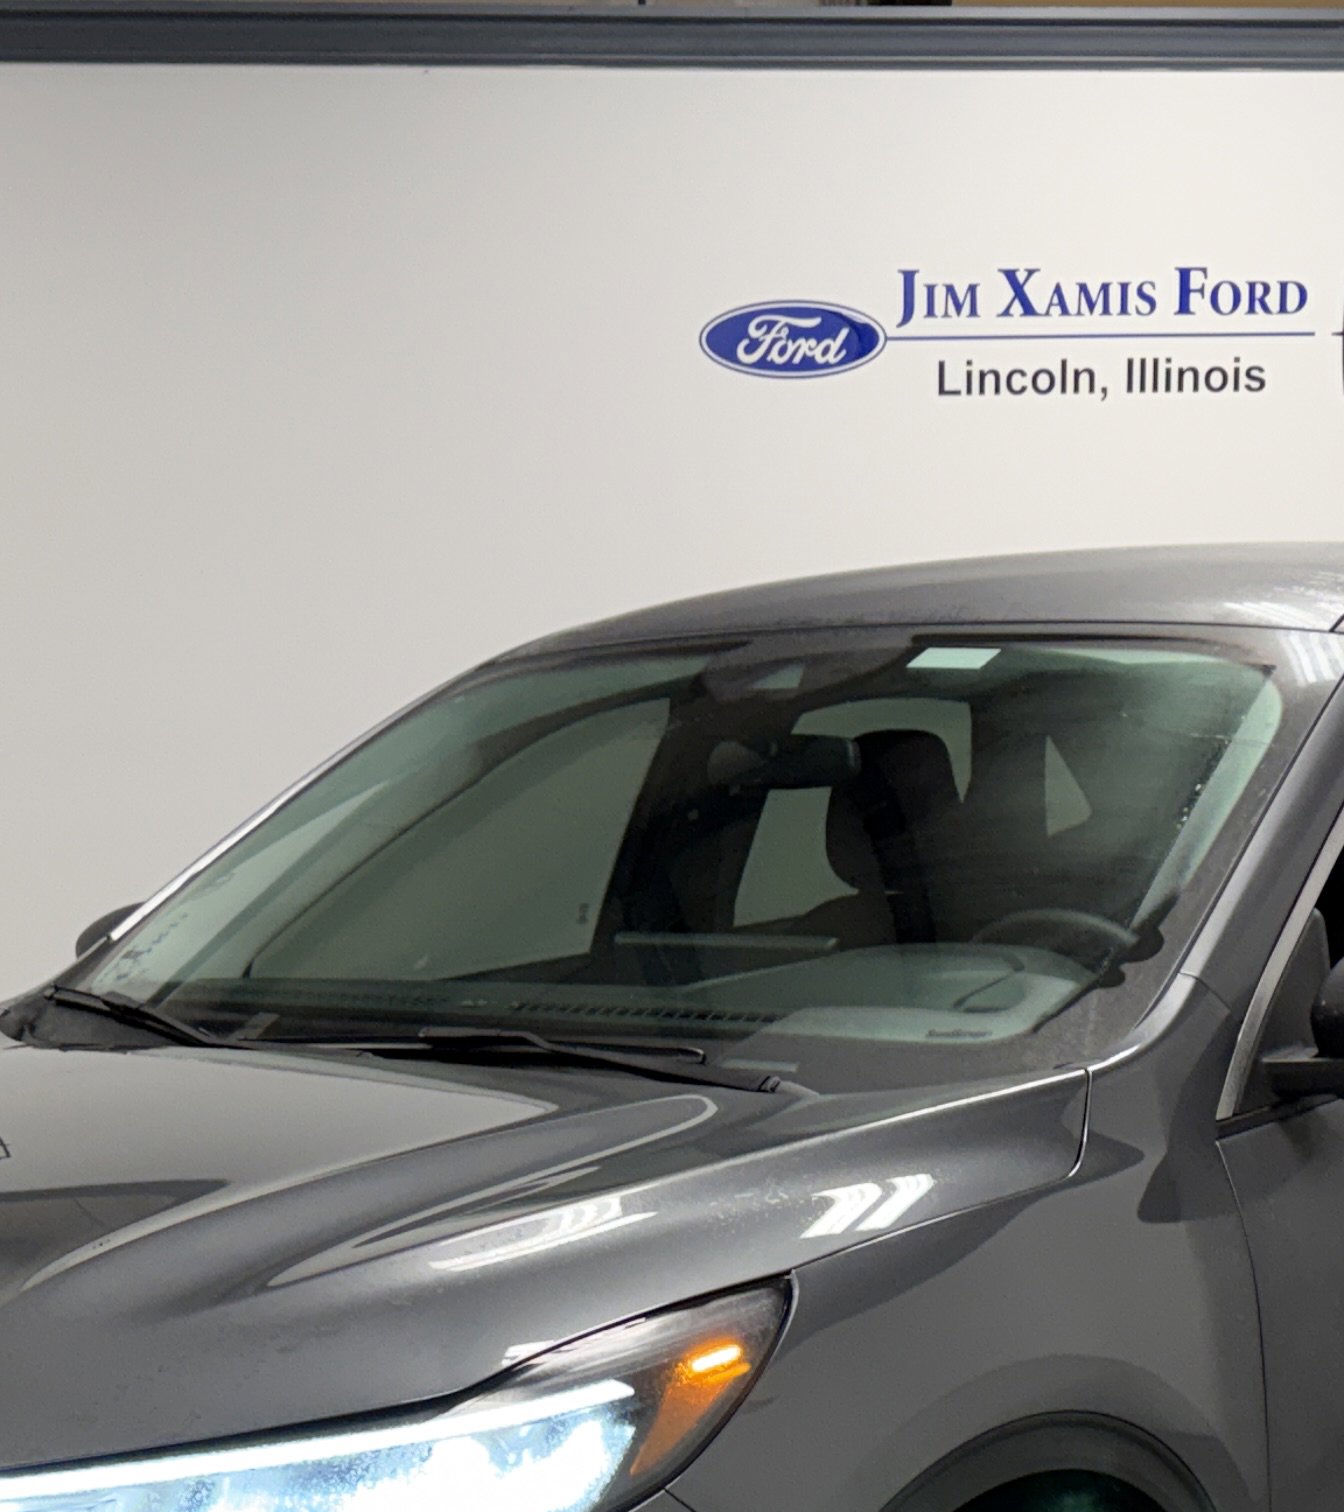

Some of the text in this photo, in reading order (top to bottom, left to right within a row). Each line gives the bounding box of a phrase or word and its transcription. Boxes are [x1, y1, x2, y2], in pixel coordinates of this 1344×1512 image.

[1174, 267, 1308, 316] FORD
[735, 314, 851, 365] Ford
[937, 357, 1266, 399] Lincoln, Illinois
